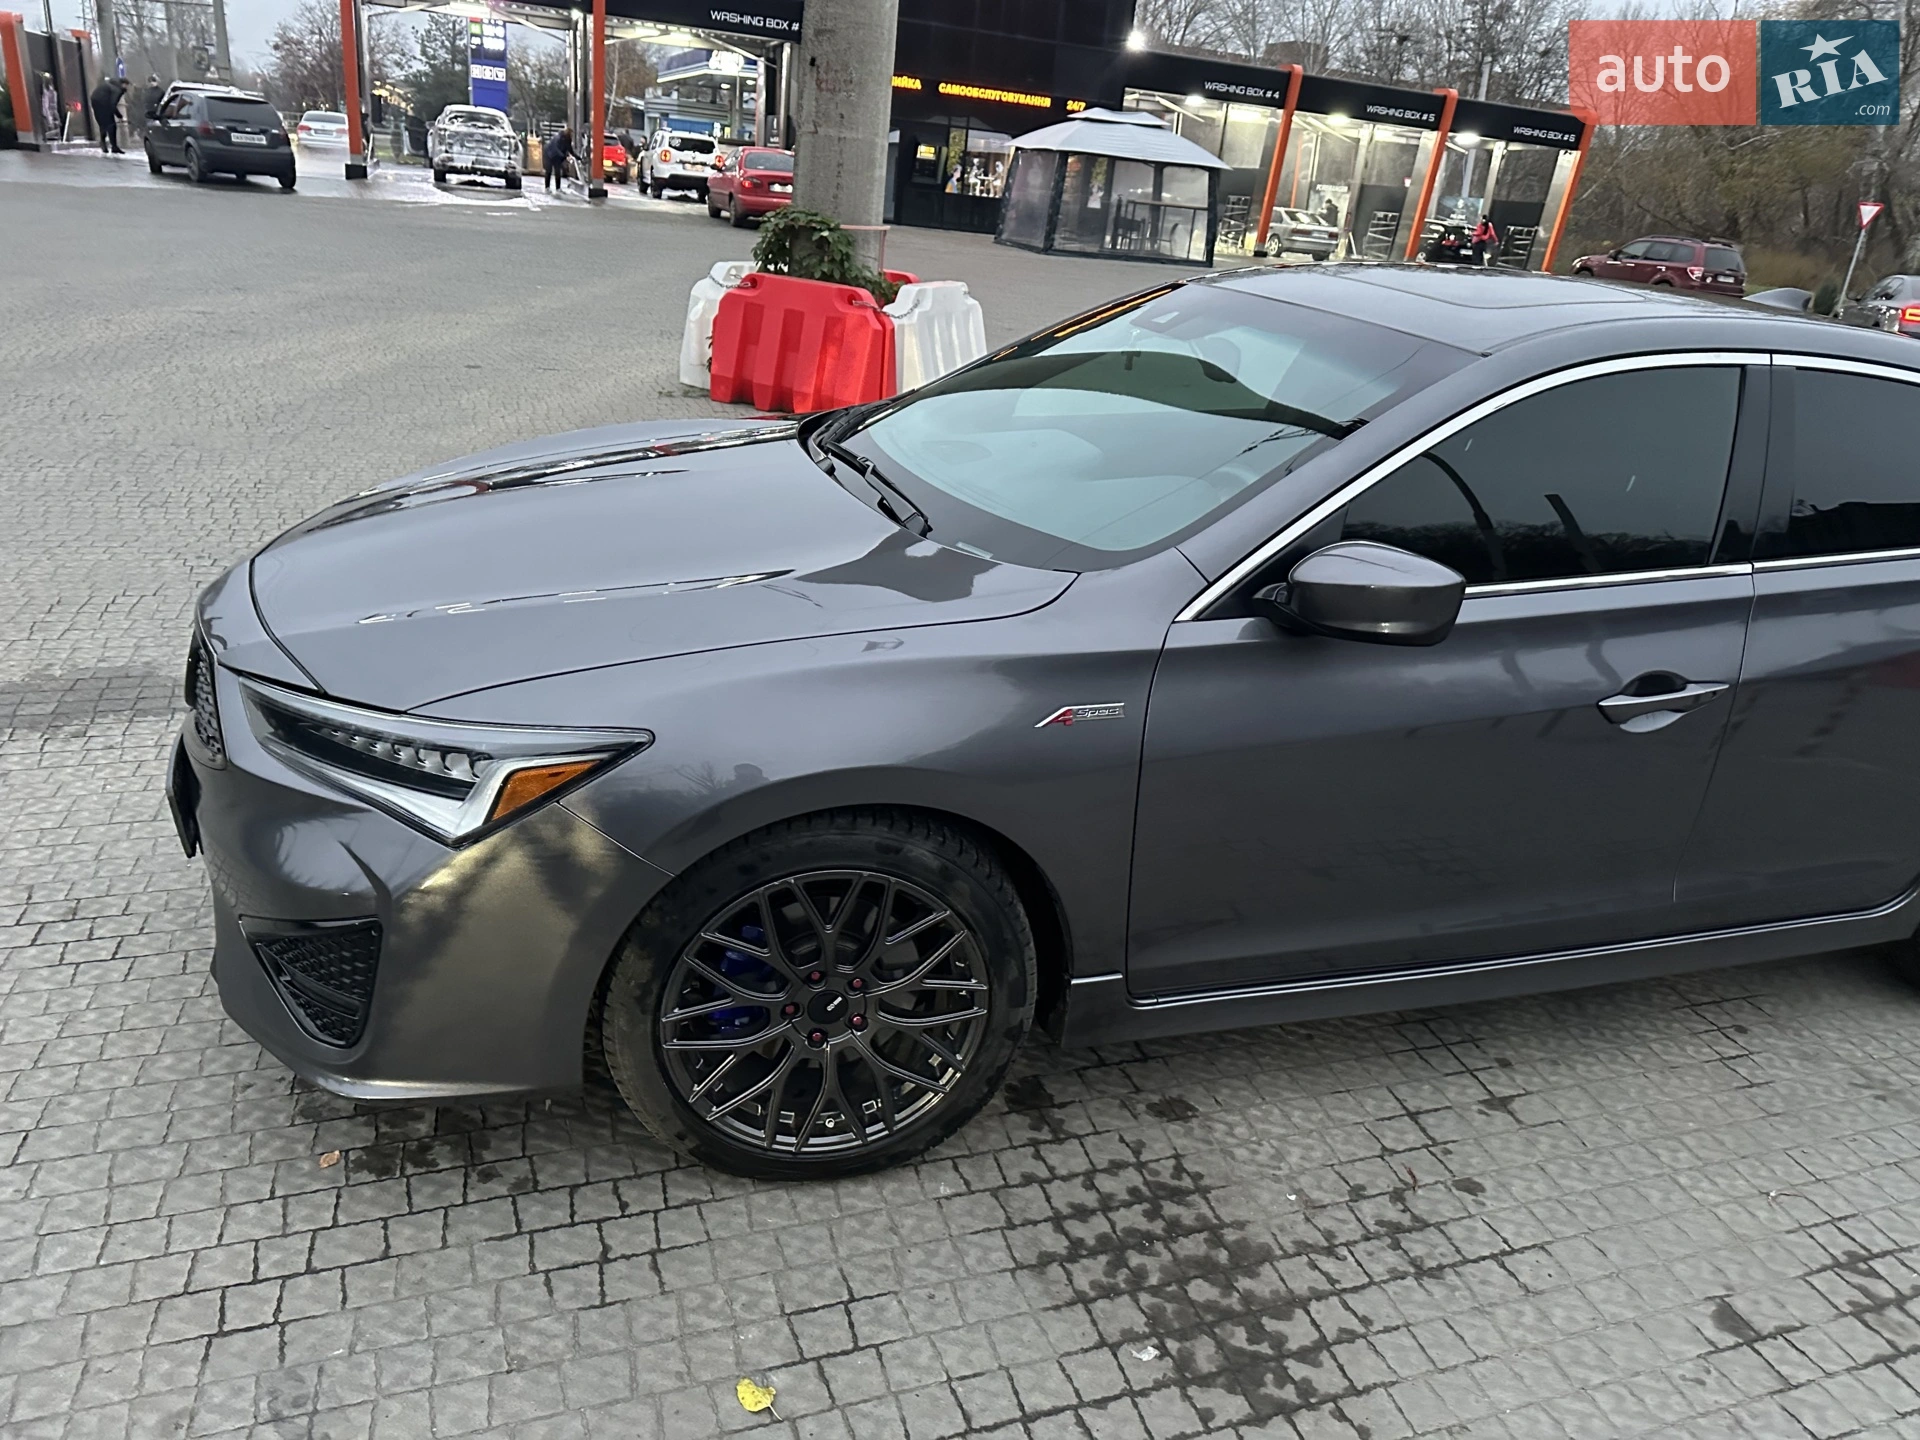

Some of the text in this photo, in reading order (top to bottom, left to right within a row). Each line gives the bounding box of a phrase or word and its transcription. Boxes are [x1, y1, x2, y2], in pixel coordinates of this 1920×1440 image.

[710, 10, 764, 27] WASHING
[766, 17, 789, 30] BOX
[938, 82, 1052, 108] САМООБСЛУГОВУВАННЯ
[1066, 100, 1087, 112] 24/7
[1204, 81, 1246, 95] WASHING
[1246, 87, 1265, 97] BOX
[1366, 105, 1404, 117] WASHING
[1404, 110, 1421, 120] BOX
[1513, 126, 1547, 138] WASHING
[1547, 131, 1563, 140] BOX
